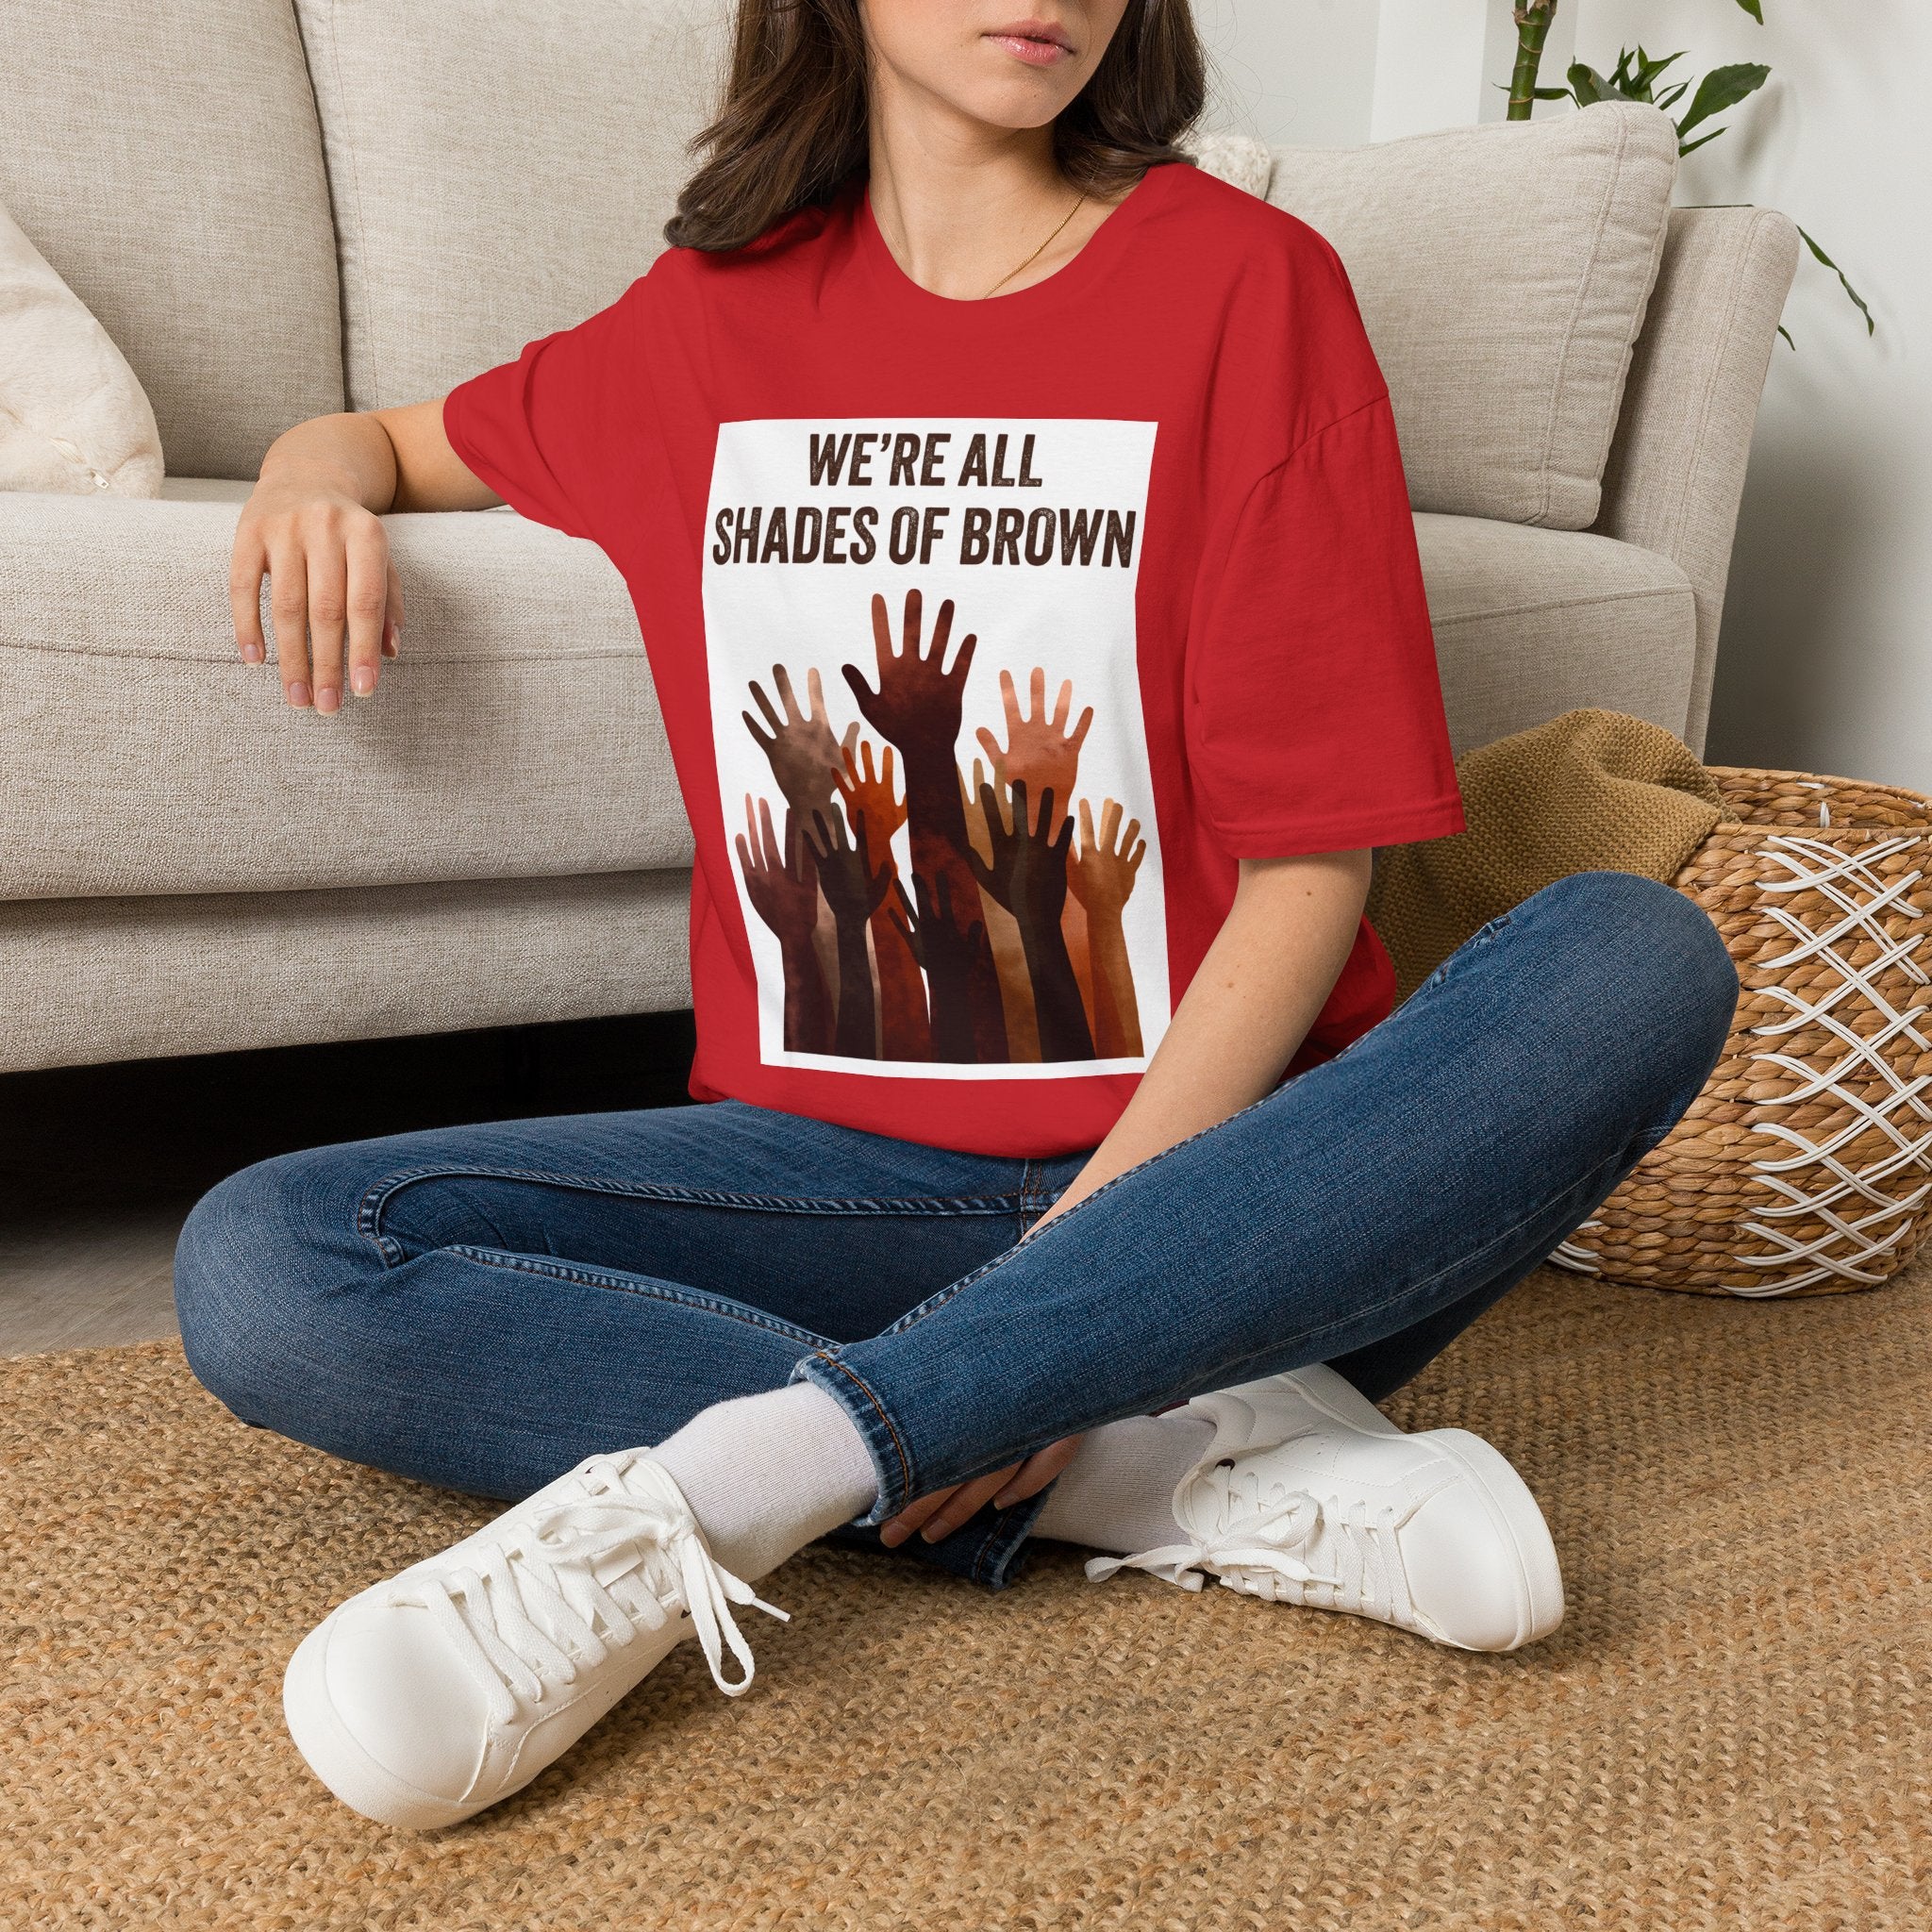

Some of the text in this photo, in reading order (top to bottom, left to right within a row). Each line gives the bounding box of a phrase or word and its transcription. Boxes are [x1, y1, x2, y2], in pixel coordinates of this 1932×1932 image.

[809, 433, 1042, 488] WE'RE ALL
[712, 507, 1137, 569] SHADES OF BROWN
